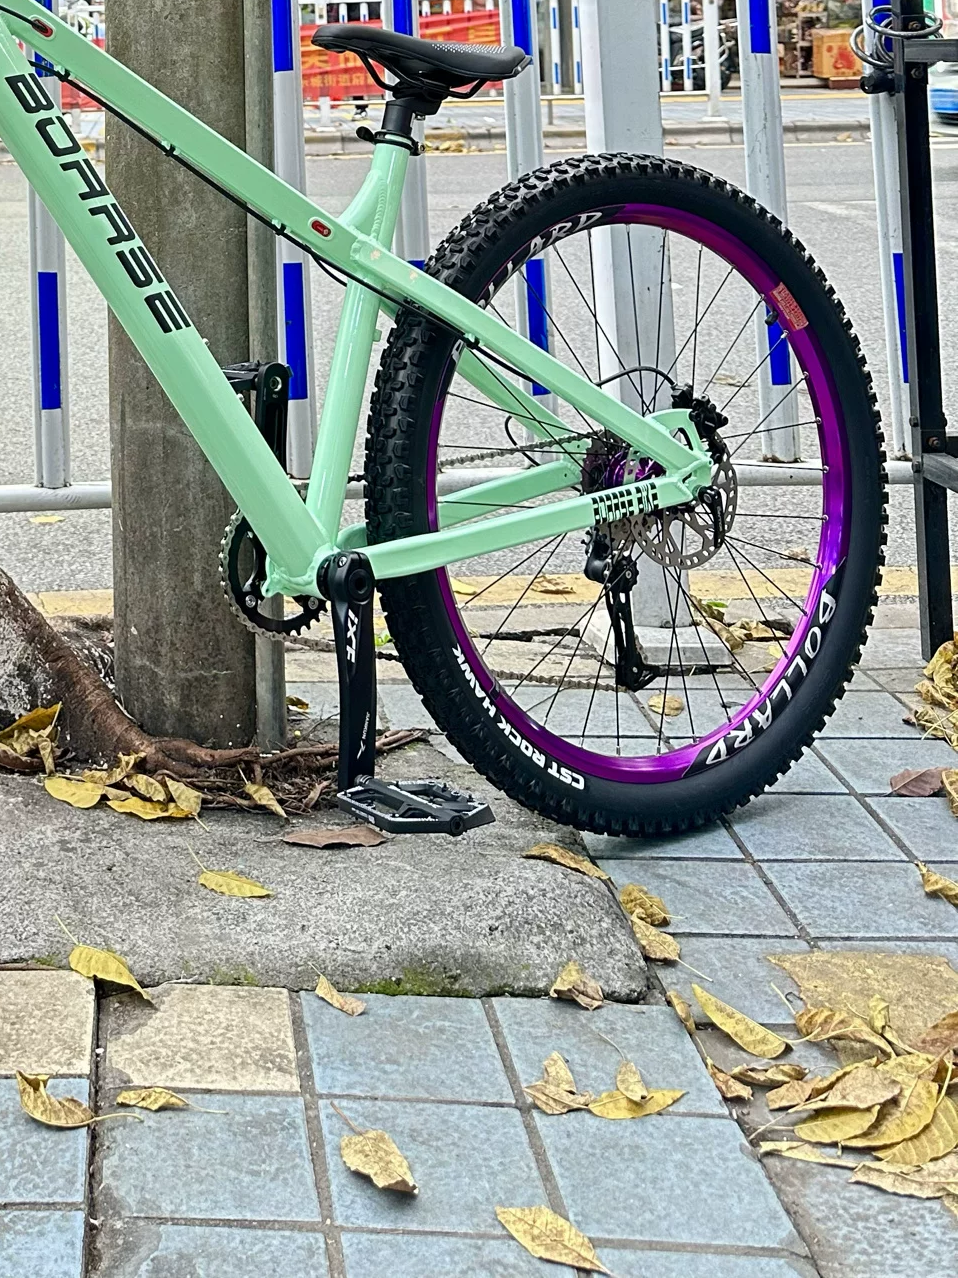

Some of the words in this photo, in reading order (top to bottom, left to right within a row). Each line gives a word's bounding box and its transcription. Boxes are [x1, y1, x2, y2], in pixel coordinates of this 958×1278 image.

[451, 642, 497, 718] HAWK
[705, 588, 837, 766] BOLLARD
[497, 714, 547, 769] ROCK
[547, 760, 586, 791] CST
